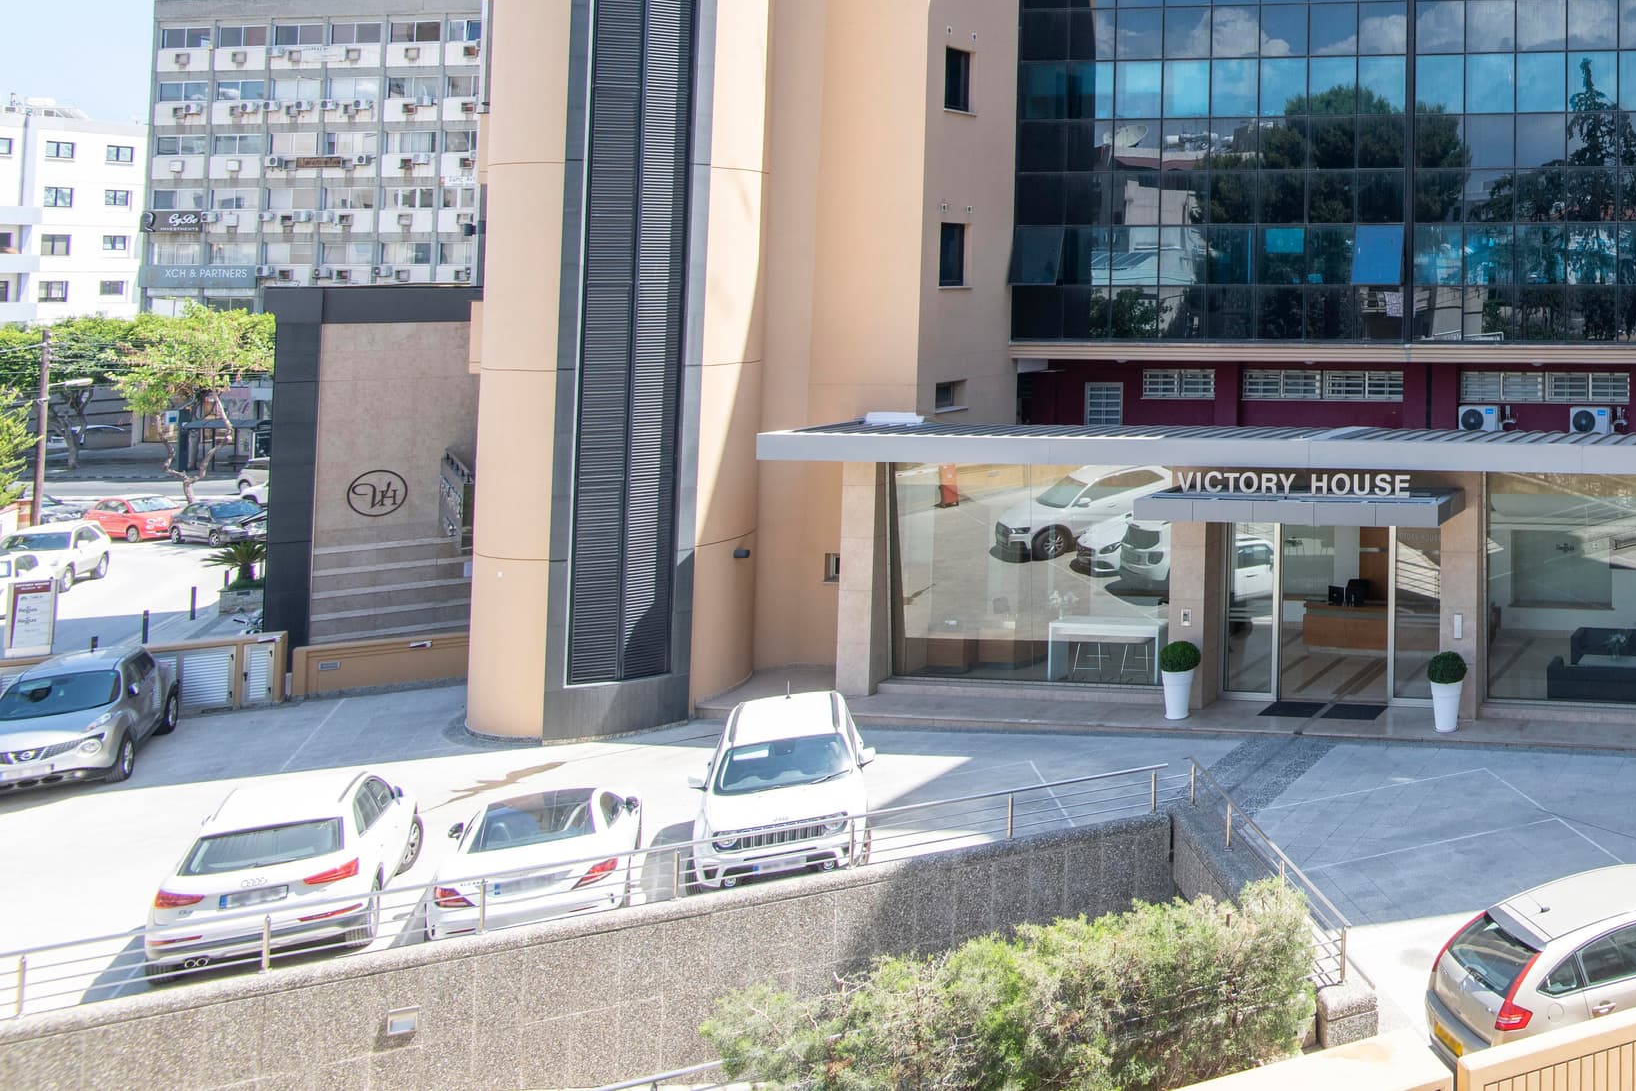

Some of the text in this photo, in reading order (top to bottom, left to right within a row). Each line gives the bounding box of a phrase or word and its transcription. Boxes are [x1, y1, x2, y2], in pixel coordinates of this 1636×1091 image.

[164, 269, 248, 279] XCH & PARTNERS
[1177, 470, 1412, 498] VICTORY HOUSE
